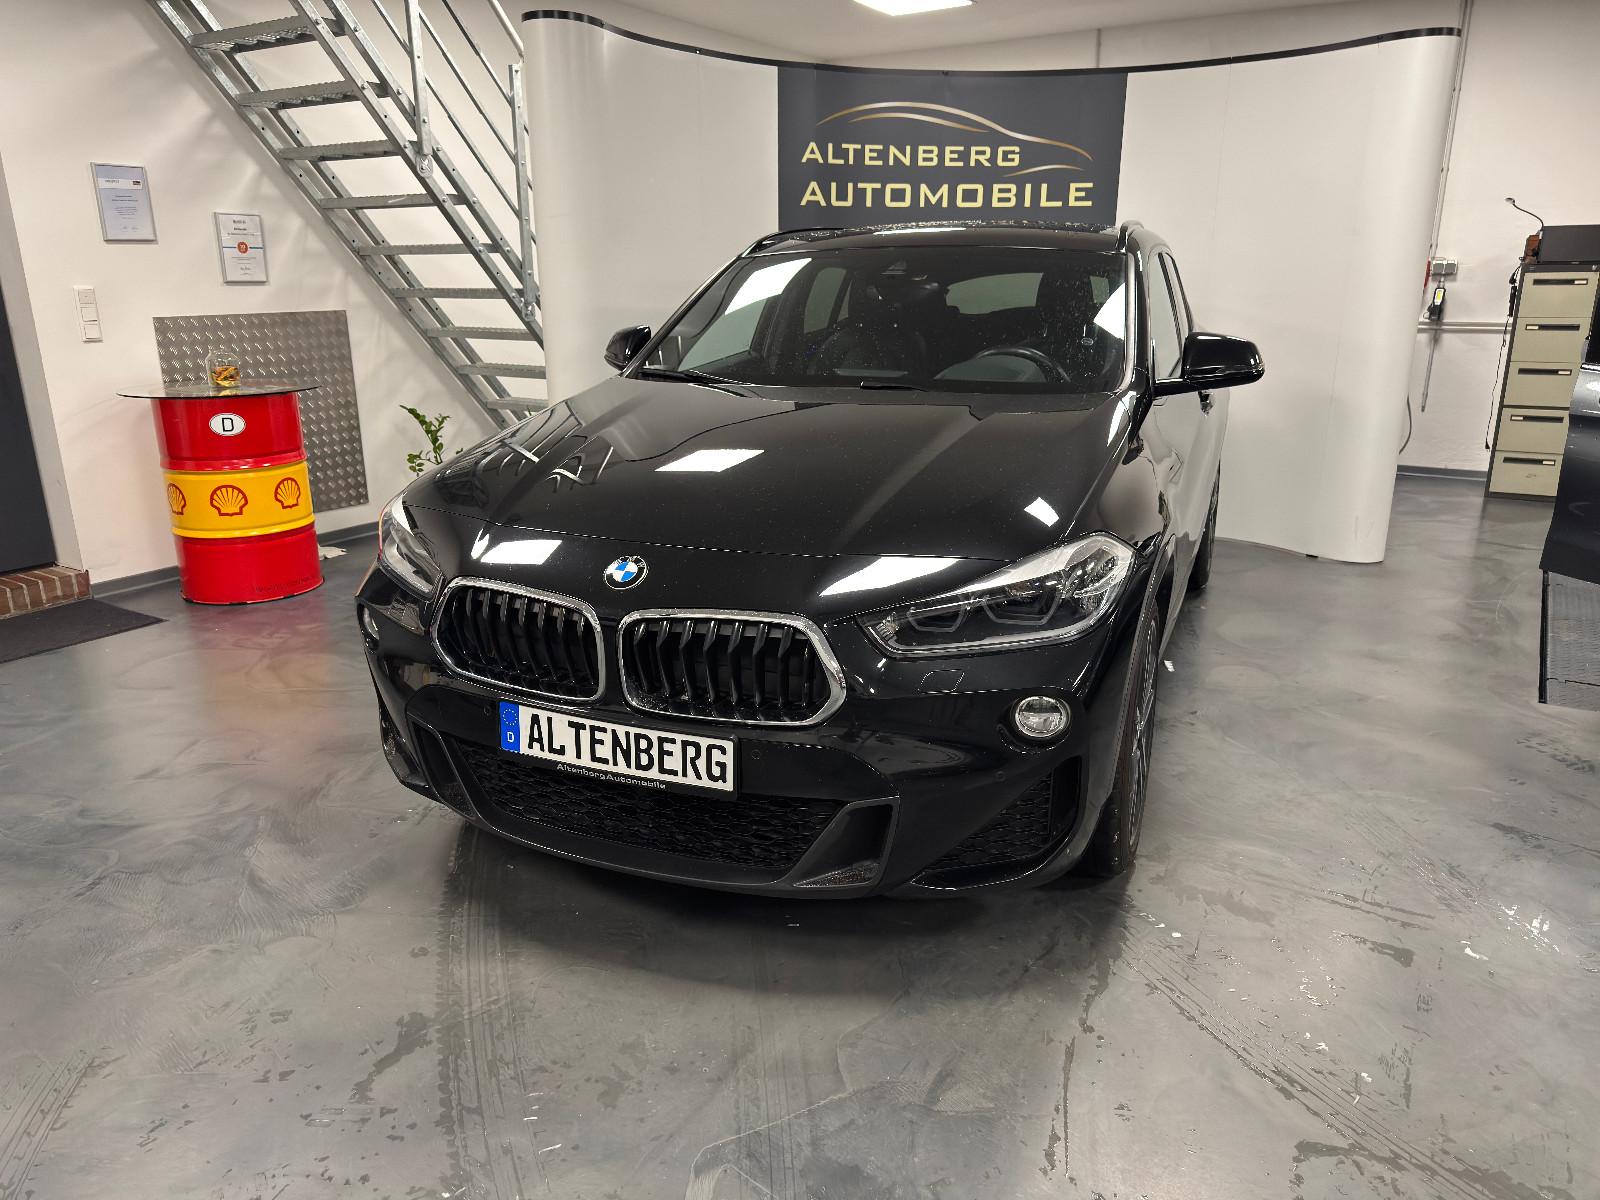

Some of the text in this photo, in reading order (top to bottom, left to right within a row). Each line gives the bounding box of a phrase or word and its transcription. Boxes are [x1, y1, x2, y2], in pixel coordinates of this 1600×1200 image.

[801, 141, 1020, 168] ALTENBERG
[800, 181, 1094, 208] AUTOMOBILE
[222, 417, 235, 432] D
[507, 731, 515, 743] D
[527, 713, 728, 784] ALTENBERG
